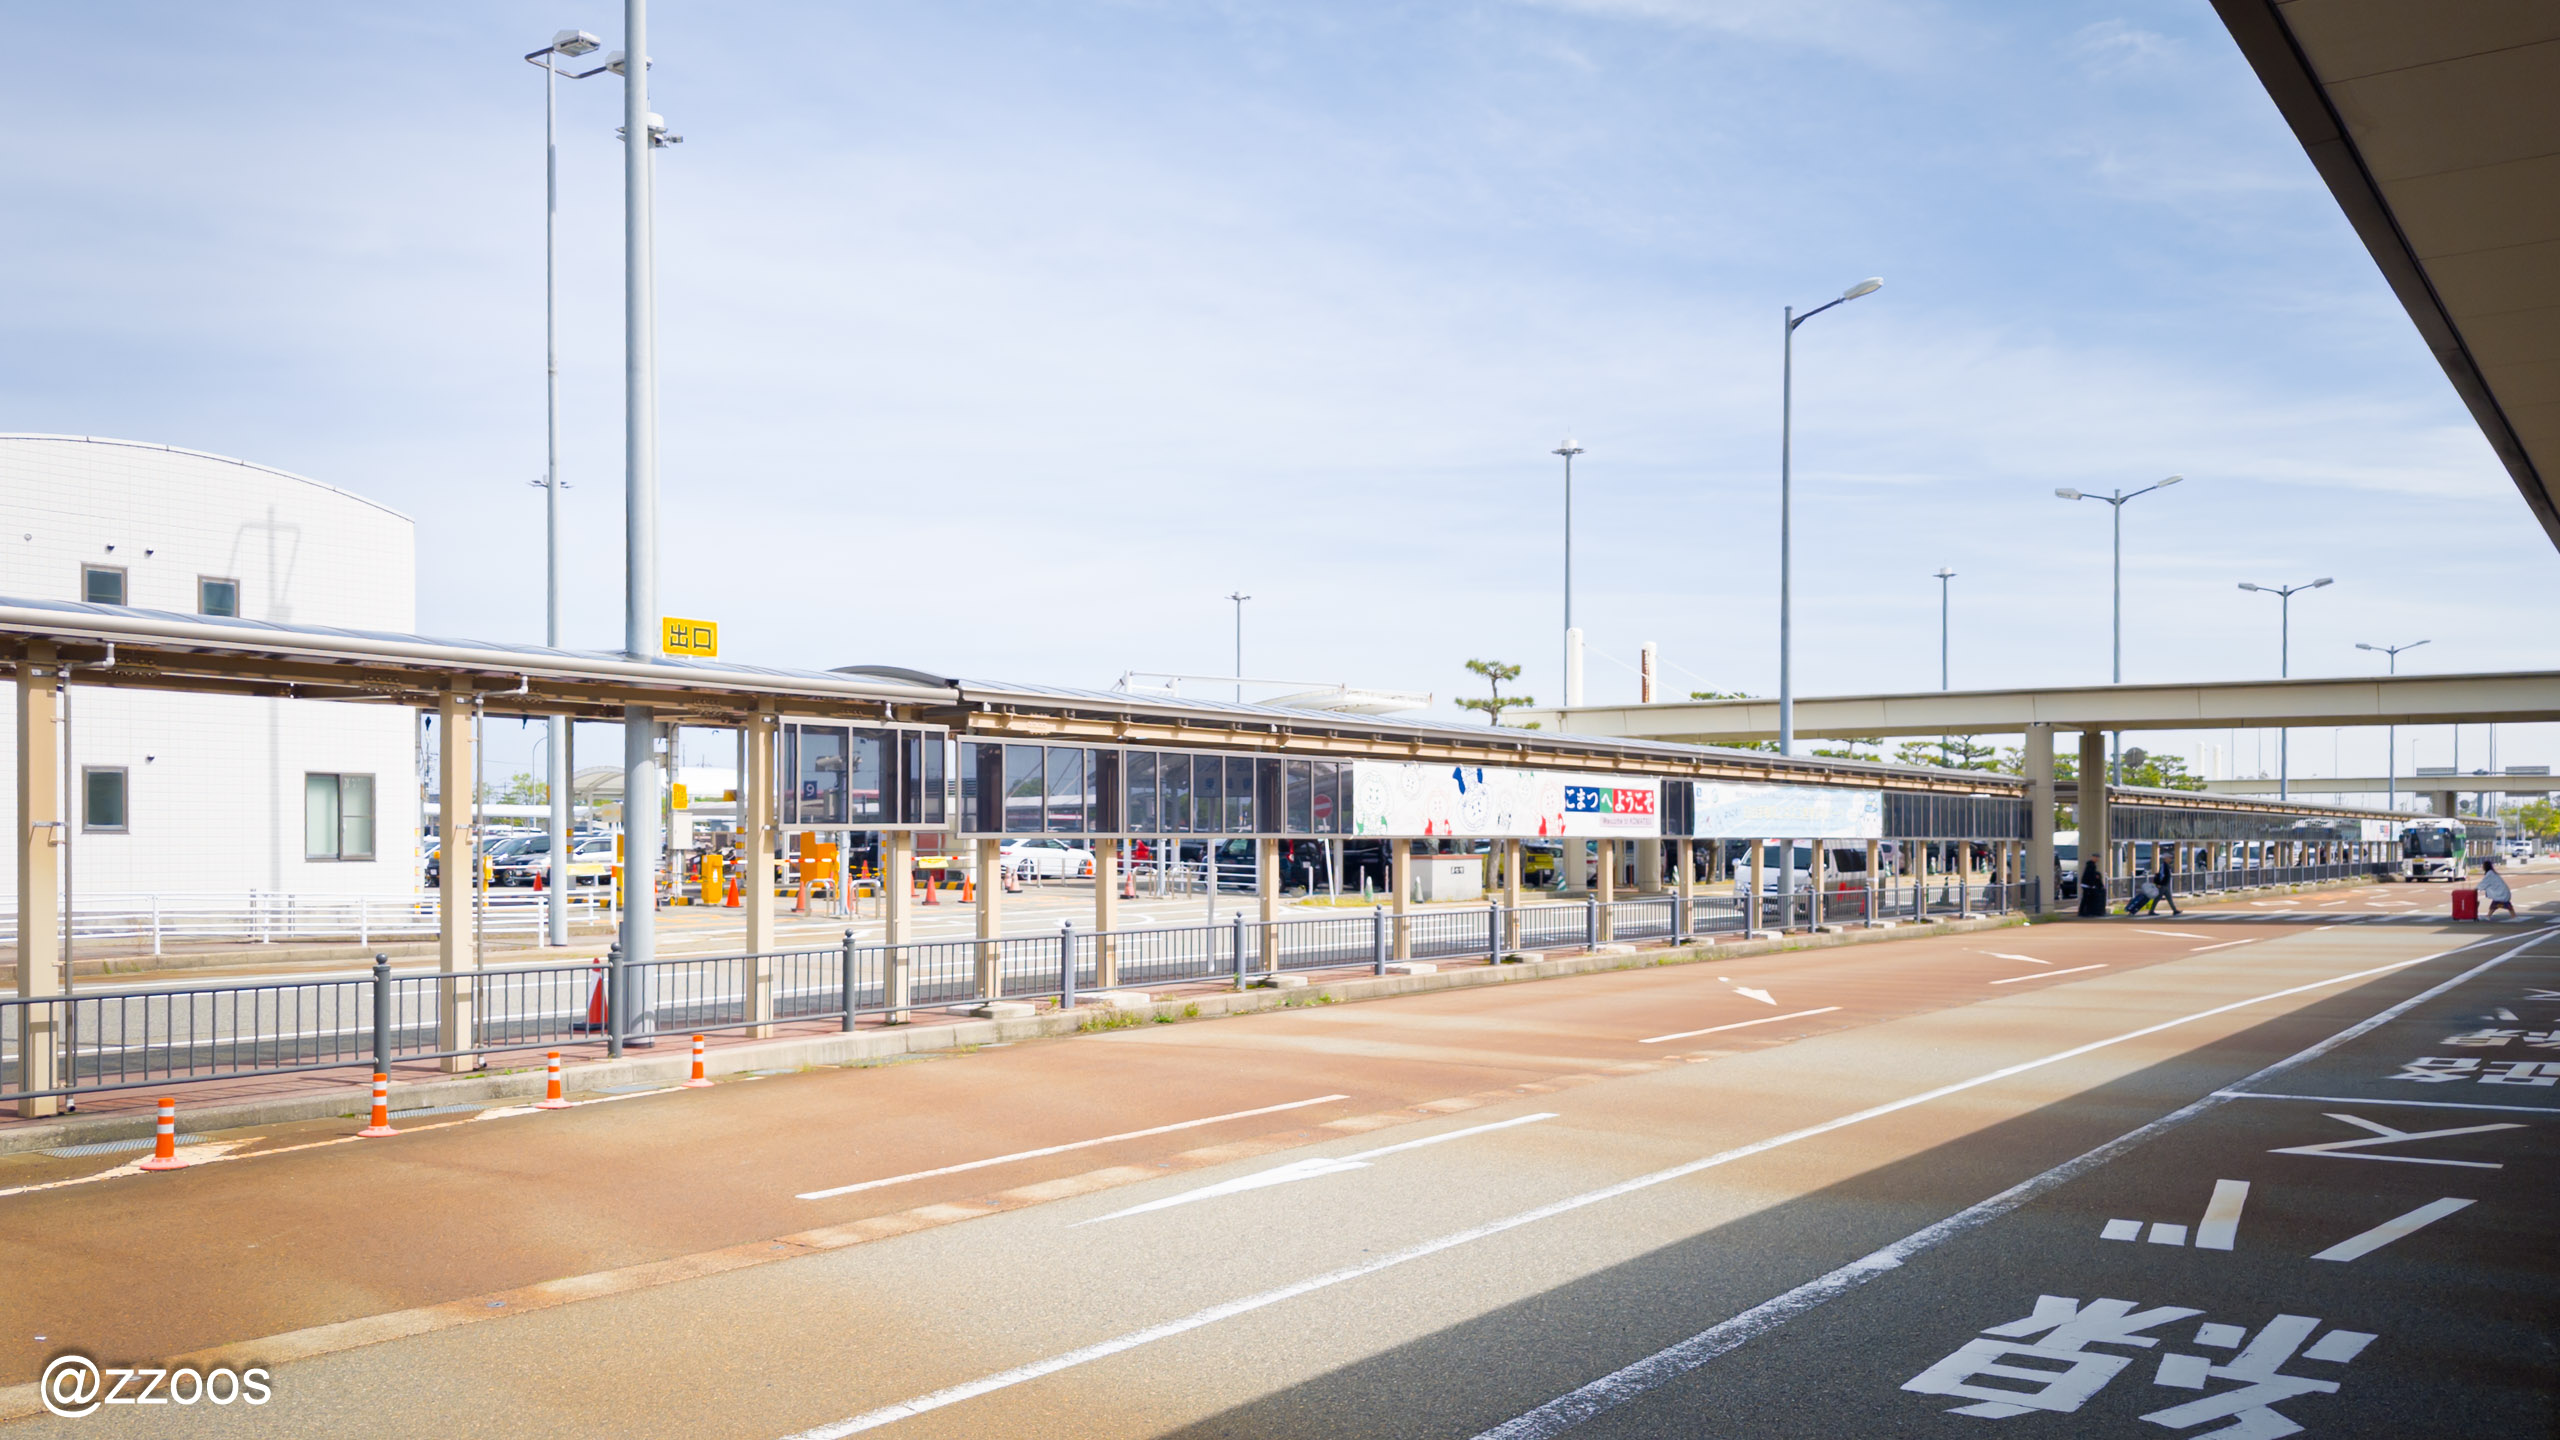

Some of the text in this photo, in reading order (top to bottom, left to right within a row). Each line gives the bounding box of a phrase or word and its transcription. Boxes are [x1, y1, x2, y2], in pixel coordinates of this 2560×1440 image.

[670, 624, 711, 649] 出口
[806, 783, 815, 797] 9
[1566, 787, 1653, 813] こまつへようこそ
